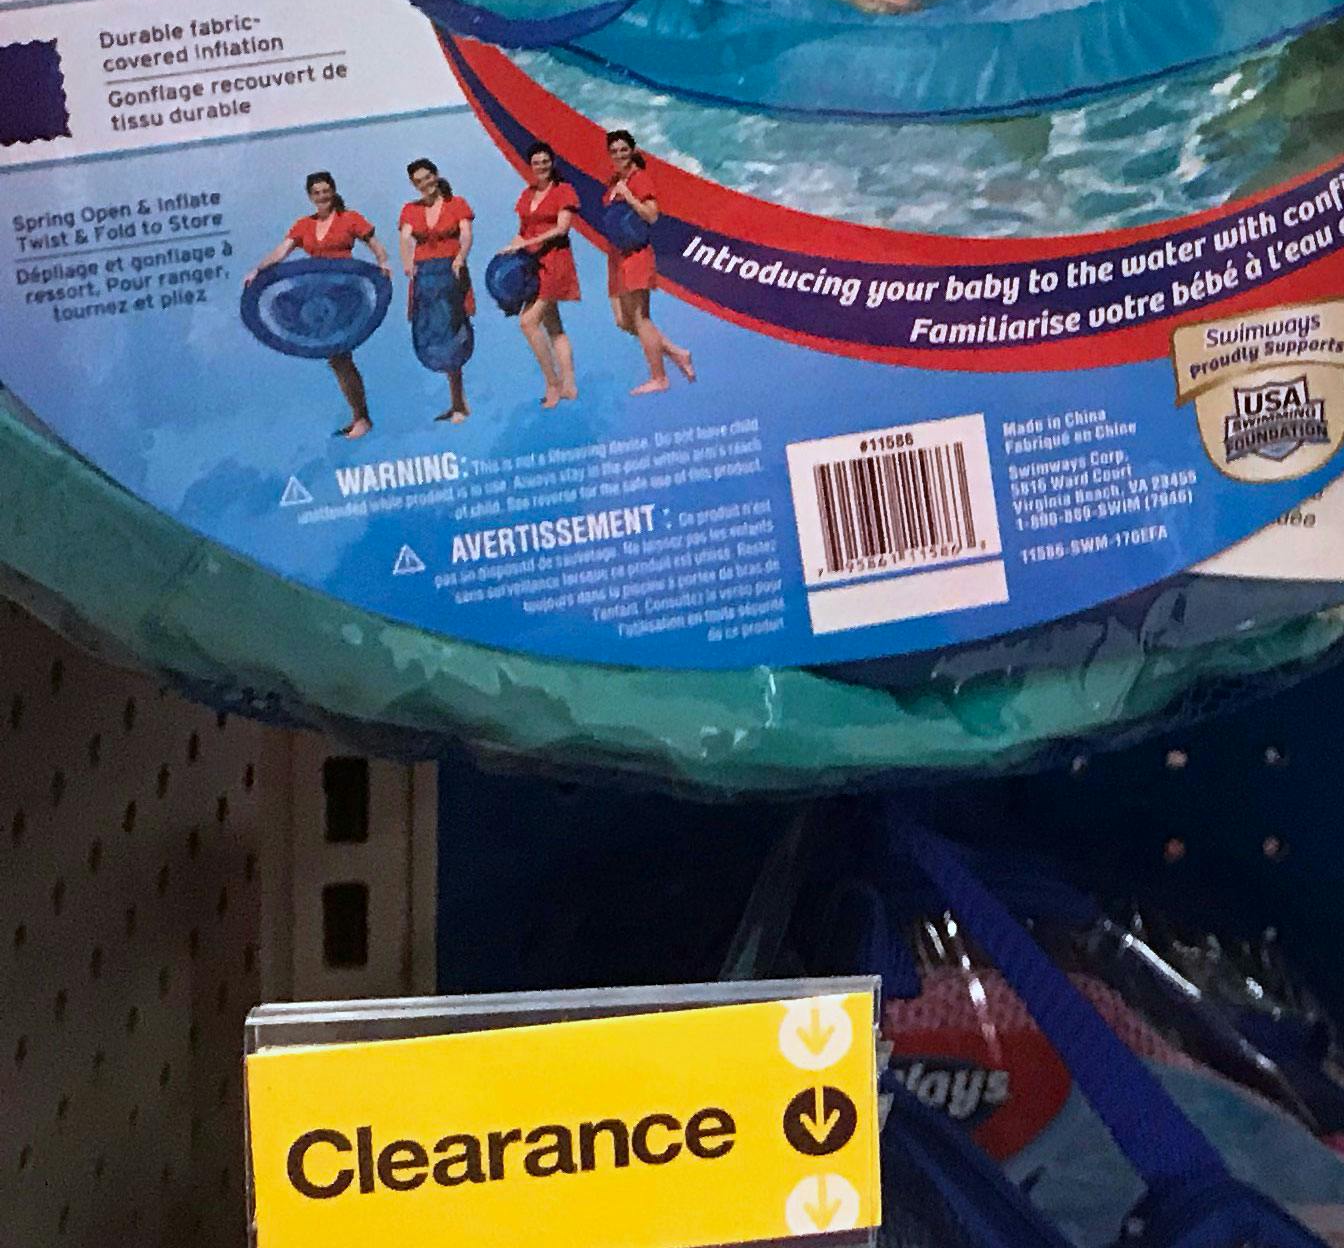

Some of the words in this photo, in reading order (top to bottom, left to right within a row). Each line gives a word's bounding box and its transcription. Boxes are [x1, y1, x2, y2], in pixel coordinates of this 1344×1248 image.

[683, 236, 861, 306] Introducing
[866, 278, 939, 308] your
[945, 272, 1020, 306] baby
[1029, 270, 1058, 295] to
[1067, 259, 1113, 287] the
[1121, 239, 1206, 279] water
[1213, 210, 1277, 252] with
[910, 310, 1081, 345] Familiarise
[1088, 291, 1165, 330] votre
[1172, 265, 1239, 308] bébé
[1245, 251, 1262, 282] à
[1268, 230, 1334, 272] l'eau
[1206, 313, 1321, 348] Swimways
[1264, 337, 1344, 356] Supports
[1243, 386, 1301, 415] USA
[336, 451, 469, 496] WARNING:
[452, 504, 655, 564] AVERTISSEMENT
[284, 1105, 737, 1201] Clearance
